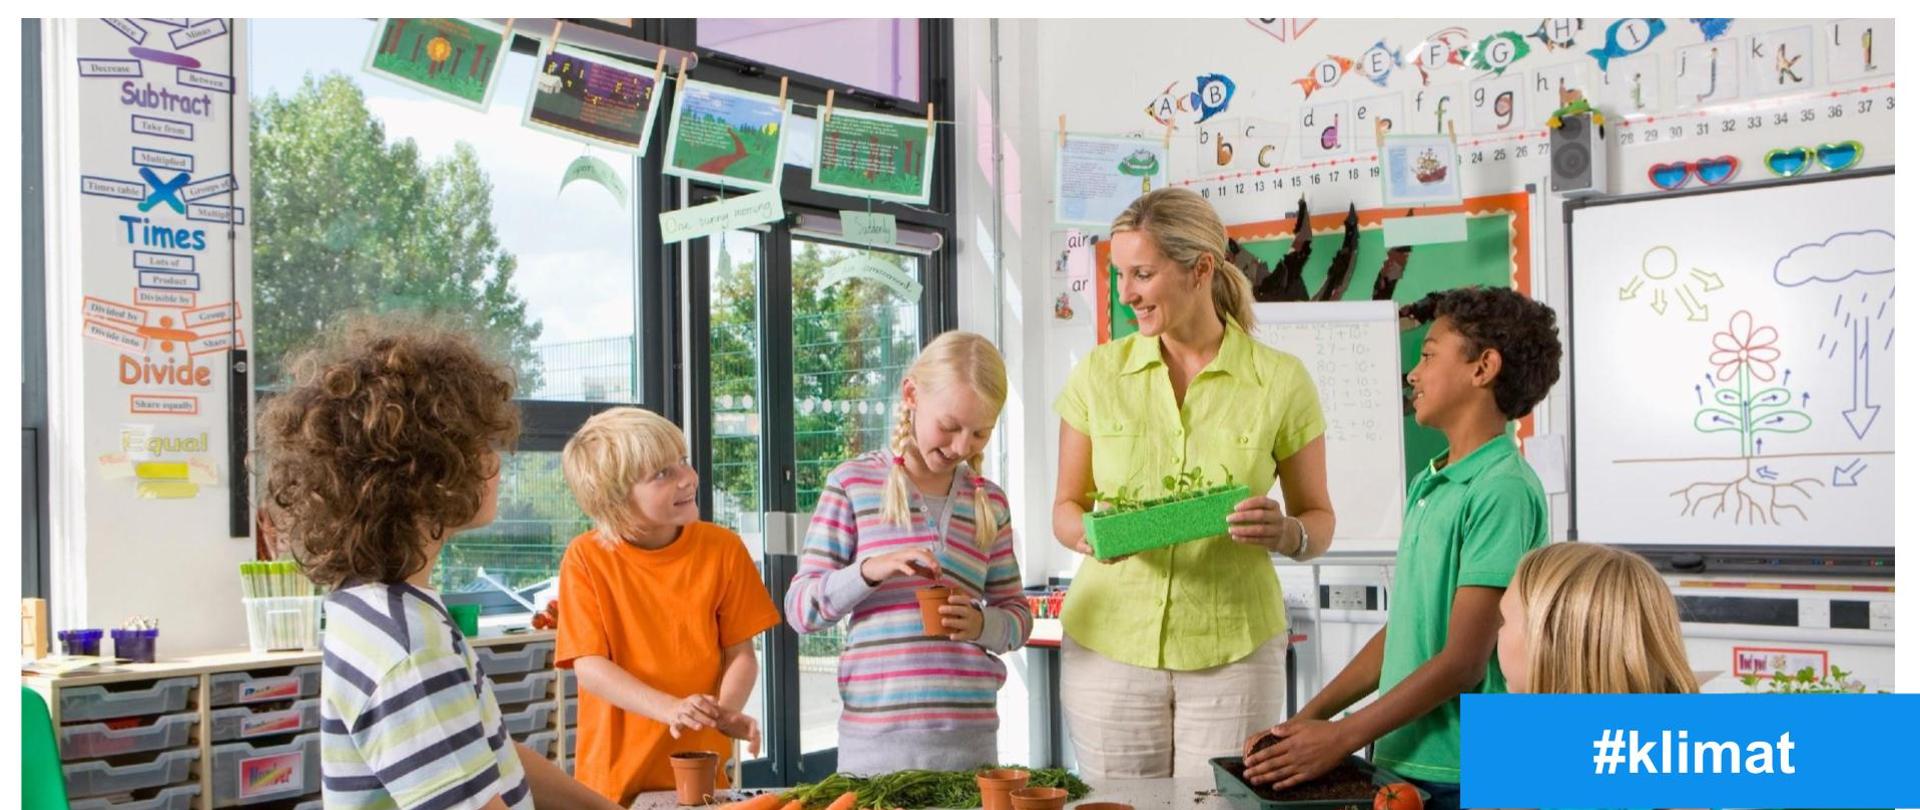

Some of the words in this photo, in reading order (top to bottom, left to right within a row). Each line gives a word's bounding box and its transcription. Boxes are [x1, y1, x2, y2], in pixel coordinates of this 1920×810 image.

[1554, 18, 1570, 39] H
[1625, 23, 1641, 45] I
[1372, 53, 1383, 73] E
[1430, 46, 1441, 65] F
[1492, 44, 1507, 64] G
[1752, 38, 1763, 58] k
[1776, 44, 1802, 84] k
[91, 63, 130, 74] Decrease
[1323, 63, 1336, 82] D
[1679, 52, 1686, 77] j
[1697, 47, 1718, 102] j
[189, 73, 224, 88] Between
[1537, 72, 1548, 91] h
[121, 81, 212, 117] Subtract
[1209, 85, 1221, 104] B
[1416, 91, 1423, 112] f
[1159, 98, 1171, 115] A
[1357, 106, 1366, 120] e
[1474, 88, 1484, 107] g
[1494, 91, 1513, 129] g
[142, 121, 163, 131] Take
[164, 124, 186, 136] from
[1304, 108, 1314, 127] d
[1321, 114, 1340, 150] d
[1200, 187, 1210, 199] 10
[1218, 185, 1227, 198] 11
[1235, 182, 1245, 194] 12
[1255, 181, 1264, 192] 13
[1273, 178, 1283, 189] 14
[1292, 176, 1301, 187] 15
[1311, 174, 1320, 184] 16
[1329, 171, 1339, 182] 17
[1349, 168, 1359, 180] 18
[1369, 165, 1380, 178] 19
[1472, 152, 1483, 163] 24
[1494, 149, 1506, 161] 25
[1516, 145, 1527, 158] 26
[1538, 143, 1550, 157] 27
[1621, 131, 1634, 145] 28
[1645, 129, 1658, 141] 29
[1669, 126, 1682, 137] 30
[1697, 123, 1708, 135] 31
[1722, 119, 1735, 132] 32
[1748, 117, 1762, 129] 33
[1774, 113, 1788, 125] 34
[1801, 109, 1815, 122] 35
[1828, 105, 1843, 118] 36
[1858, 100, 1873, 114] 37
[1886, 93, 1895, 110] 3
[1200, 127, 1208, 144] b
[1217, 133, 1233, 166] b
[1246, 126, 1255, 137] c
[1257, 144, 1275, 168] c
[141, 152, 187, 168] Multiplied
[88, 181, 115, 193] Times
[116, 184, 140, 196] table
[189, 182, 219, 197] Groups
[119, 215, 206, 250] Times
[663, 215, 692, 233] One
[1068, 232, 1089, 248] air
[150, 256, 169, 268] Lots
[170, 257, 181, 268] of
[152, 275, 188, 286] Product
[1072, 279, 1089, 292] ar
[140, 292, 177, 304] Divisible
[179, 296, 190, 306] by
[91, 303, 125, 319] Divided
[126, 310, 138, 323] by
[199, 310, 226, 323] Group
[91, 326, 119, 341] Divide
[121, 335, 140, 347] into
[203, 338, 226, 347] Share
[119, 354, 211, 387] Divide
[135, 399, 161, 409] Share
[162, 400, 193, 411] equally
[122, 430, 208, 457] Equal
